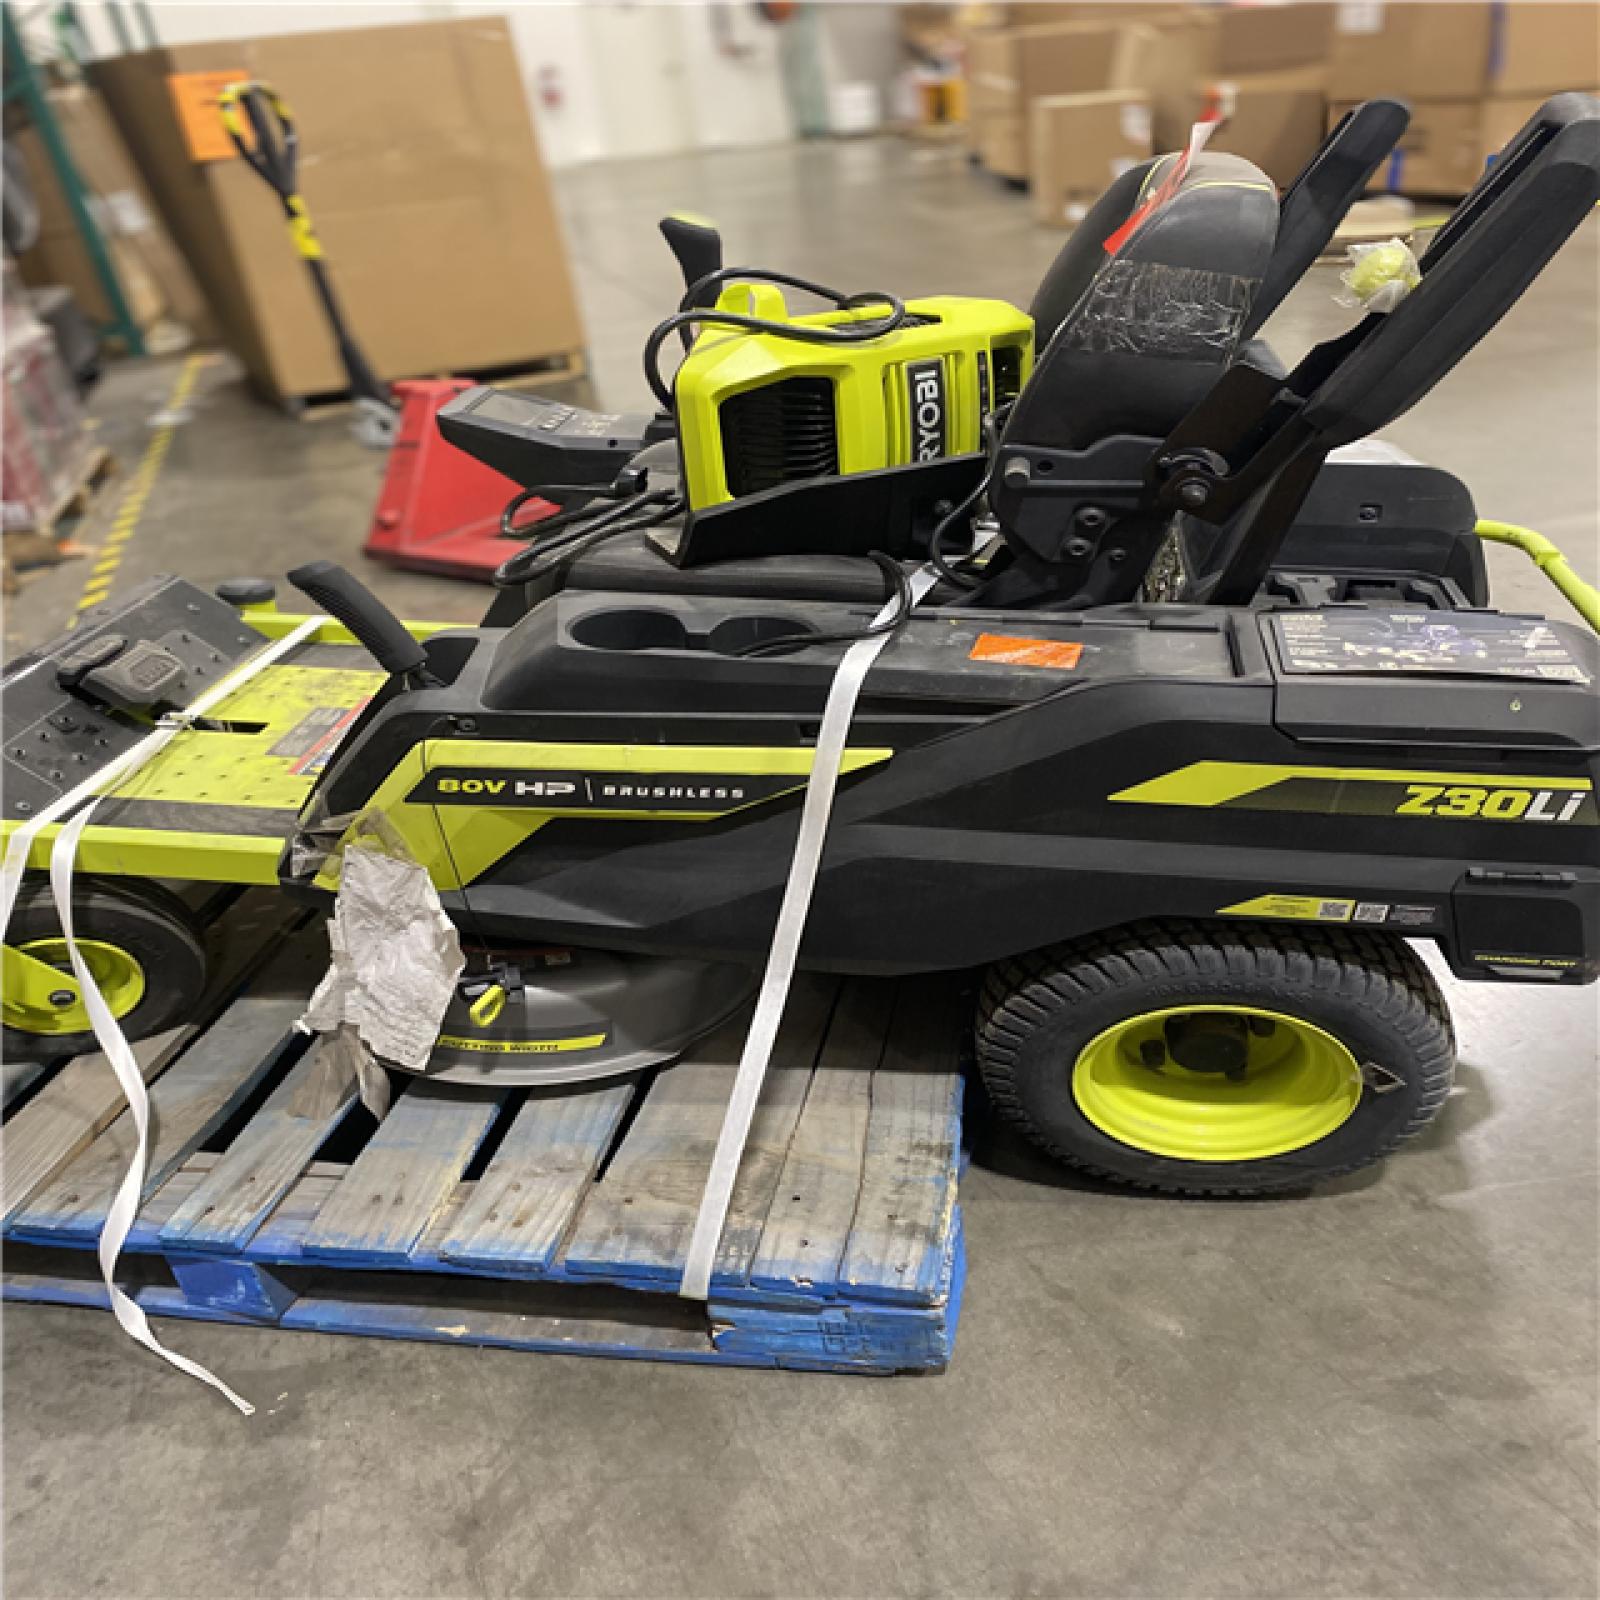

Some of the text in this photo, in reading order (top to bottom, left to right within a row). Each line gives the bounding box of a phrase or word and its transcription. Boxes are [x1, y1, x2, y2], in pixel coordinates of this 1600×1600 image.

[915, 370, 940, 463] RYOBI
[437, 779, 745, 799] 80V HP BRUSHLESS
[1396, 785, 1586, 821] Z30Li
